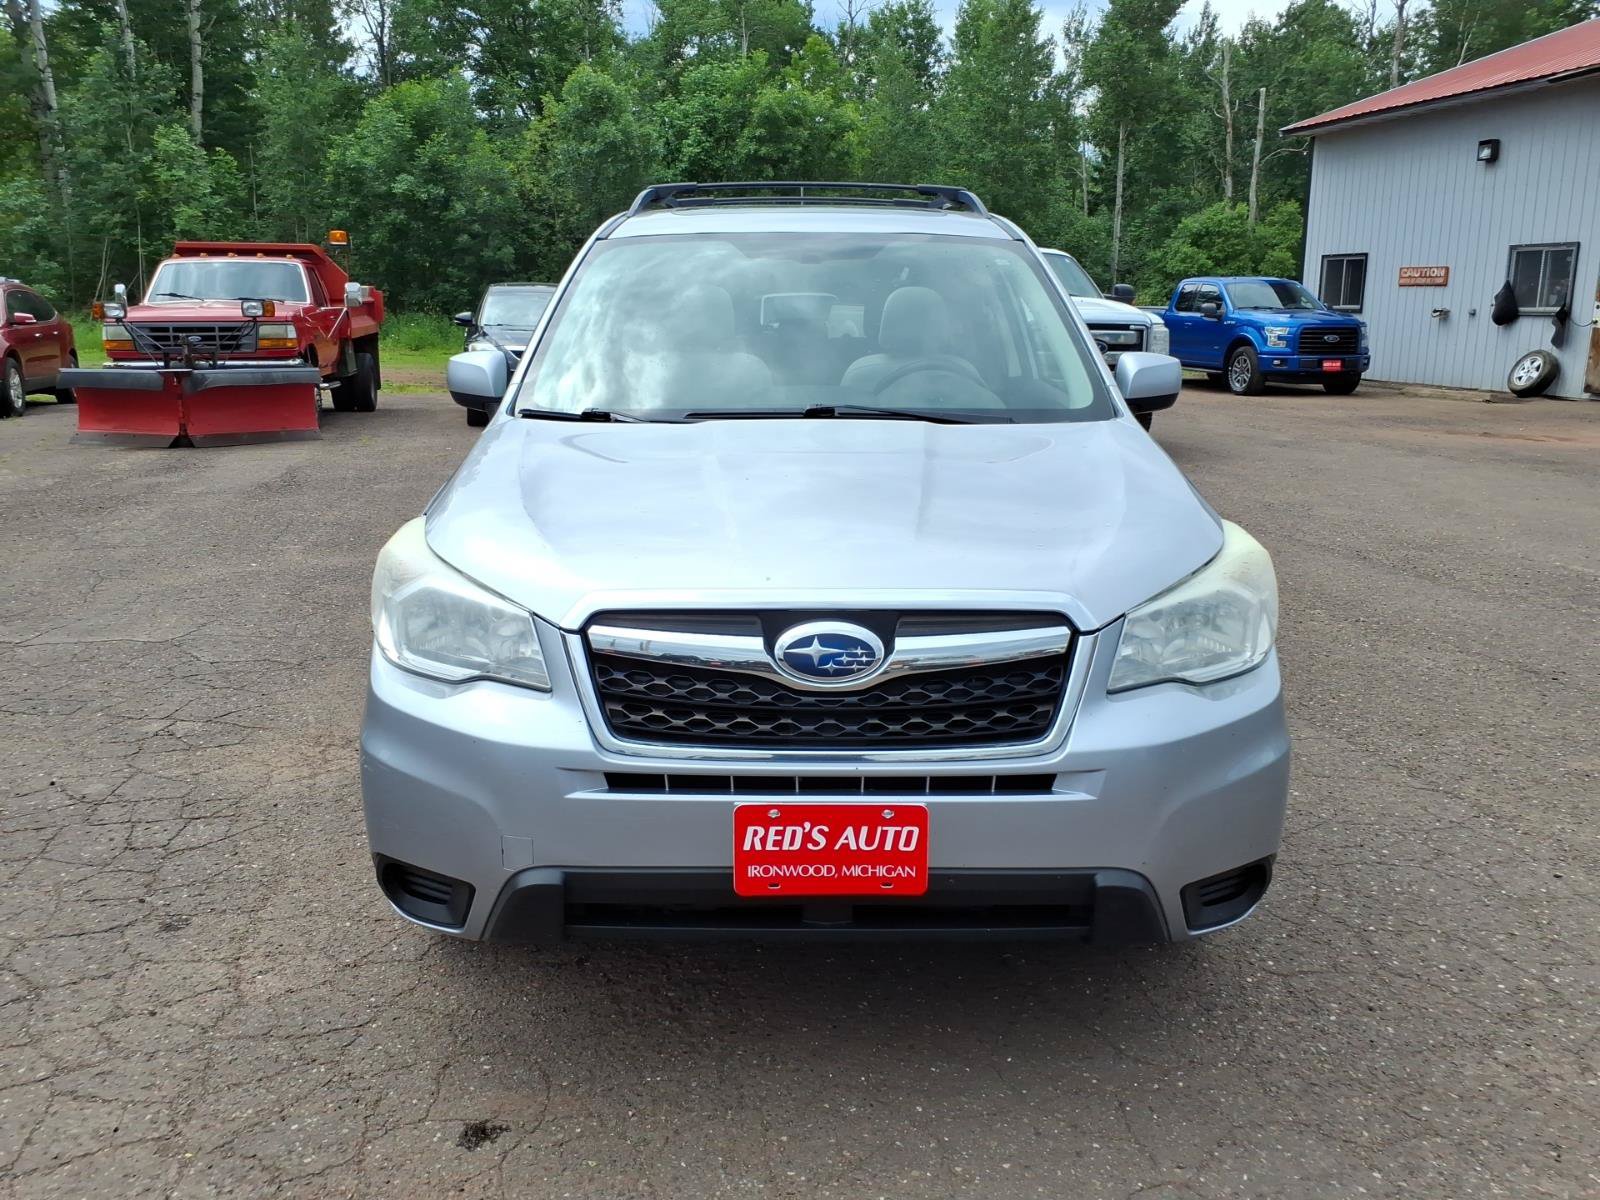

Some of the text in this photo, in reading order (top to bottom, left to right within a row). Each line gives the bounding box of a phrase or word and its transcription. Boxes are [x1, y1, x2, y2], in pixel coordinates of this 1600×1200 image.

[1400, 267, 1446, 277] CAUTION
[743, 822, 920, 851] RED'S AUTO
[747, 864, 916, 879] IRONWOOD, MICHIGAN
